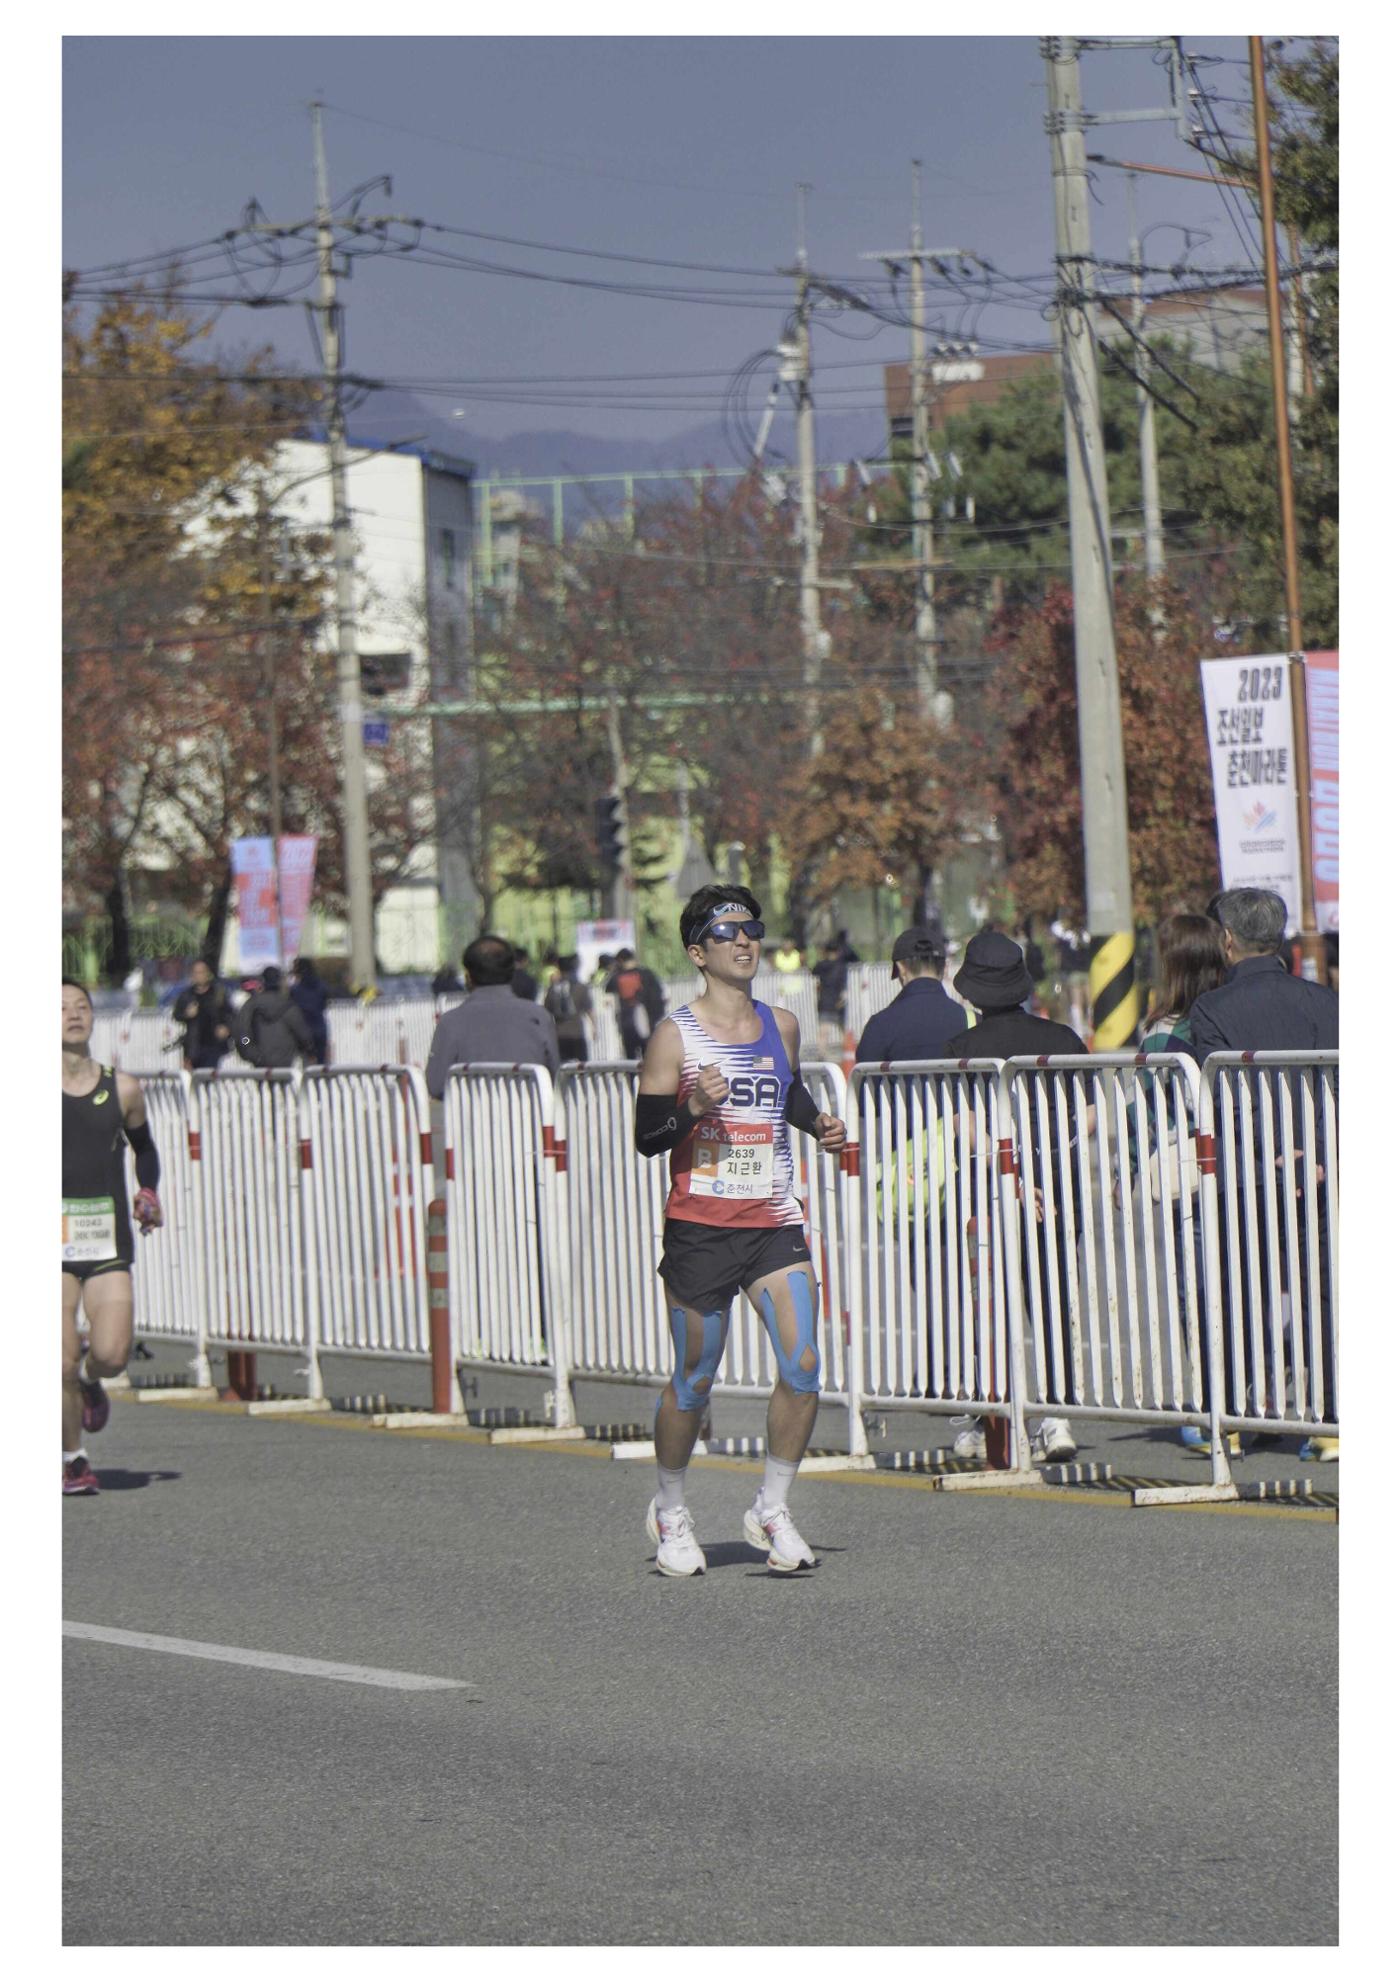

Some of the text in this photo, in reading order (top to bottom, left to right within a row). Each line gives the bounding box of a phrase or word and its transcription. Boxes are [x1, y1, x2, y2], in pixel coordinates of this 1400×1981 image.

[1238, 666, 1283, 702] 2023
[1217, 707, 1264, 746] 조선일보
[1228, 748, 1287, 788] 춘천마라톤
[717, 1077, 781, 1107] SA
[701, 1126, 766, 1142] SK telecom
[727, 1148, 755, 1159] 2639
[727, 1161, 762, 1176] 지근환
